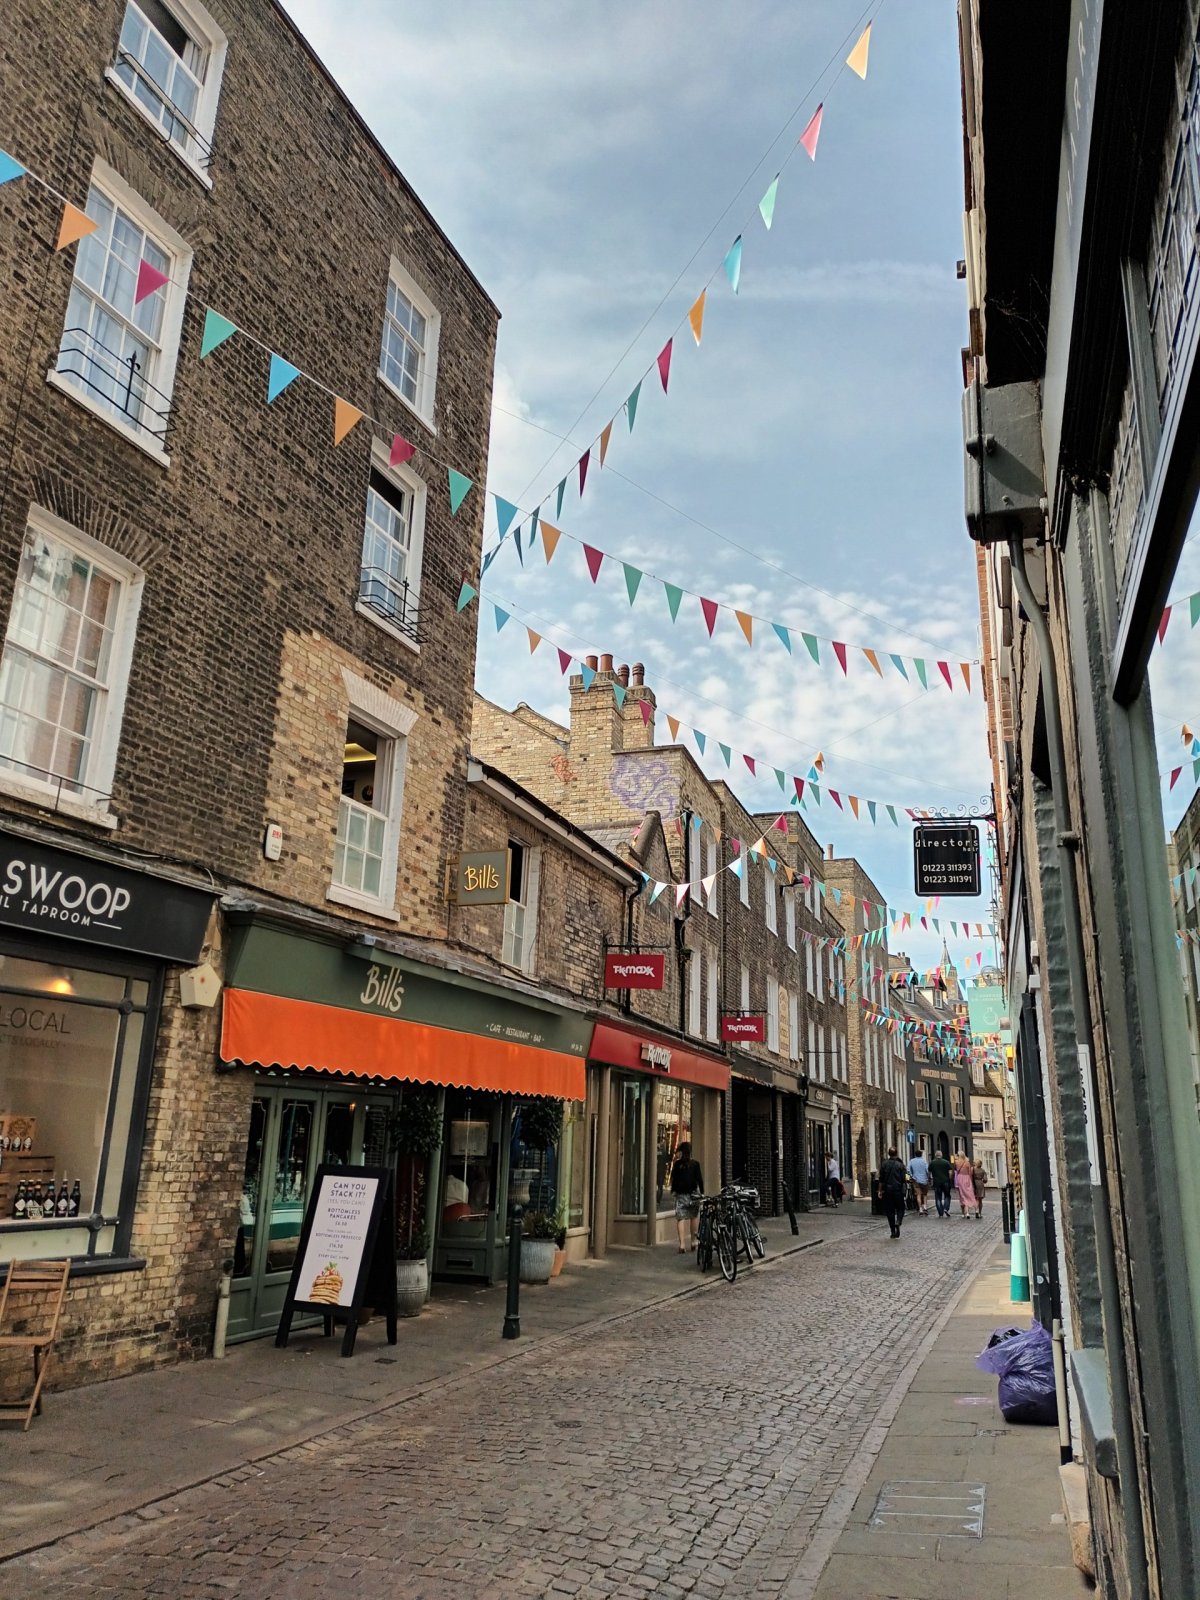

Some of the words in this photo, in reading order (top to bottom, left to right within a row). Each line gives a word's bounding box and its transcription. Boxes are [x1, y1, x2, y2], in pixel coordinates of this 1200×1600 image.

[915, 839, 978, 847] directors
[922, 864, 946, 872] 01223
[946, 863, 972, 872] 311393
[464, 864, 499, 891] Bill's
[923, 875, 947, 883] 01223
[948, 875, 972, 883] 311391
[2, 860, 131, 919] SWOOP
[22, 900, 91, 927] TAPROOM
[360, 965, 405, 1013] Bill's
[490, 1023, 501, 1033] CAFE
[505, 1026, 530, 1040] RESTAURANT
[533, 1033, 542, 1043] BAR
[330, 1190, 353, 1198] STACK
[327, 1207, 361, 1215] BOTTOMLESS
